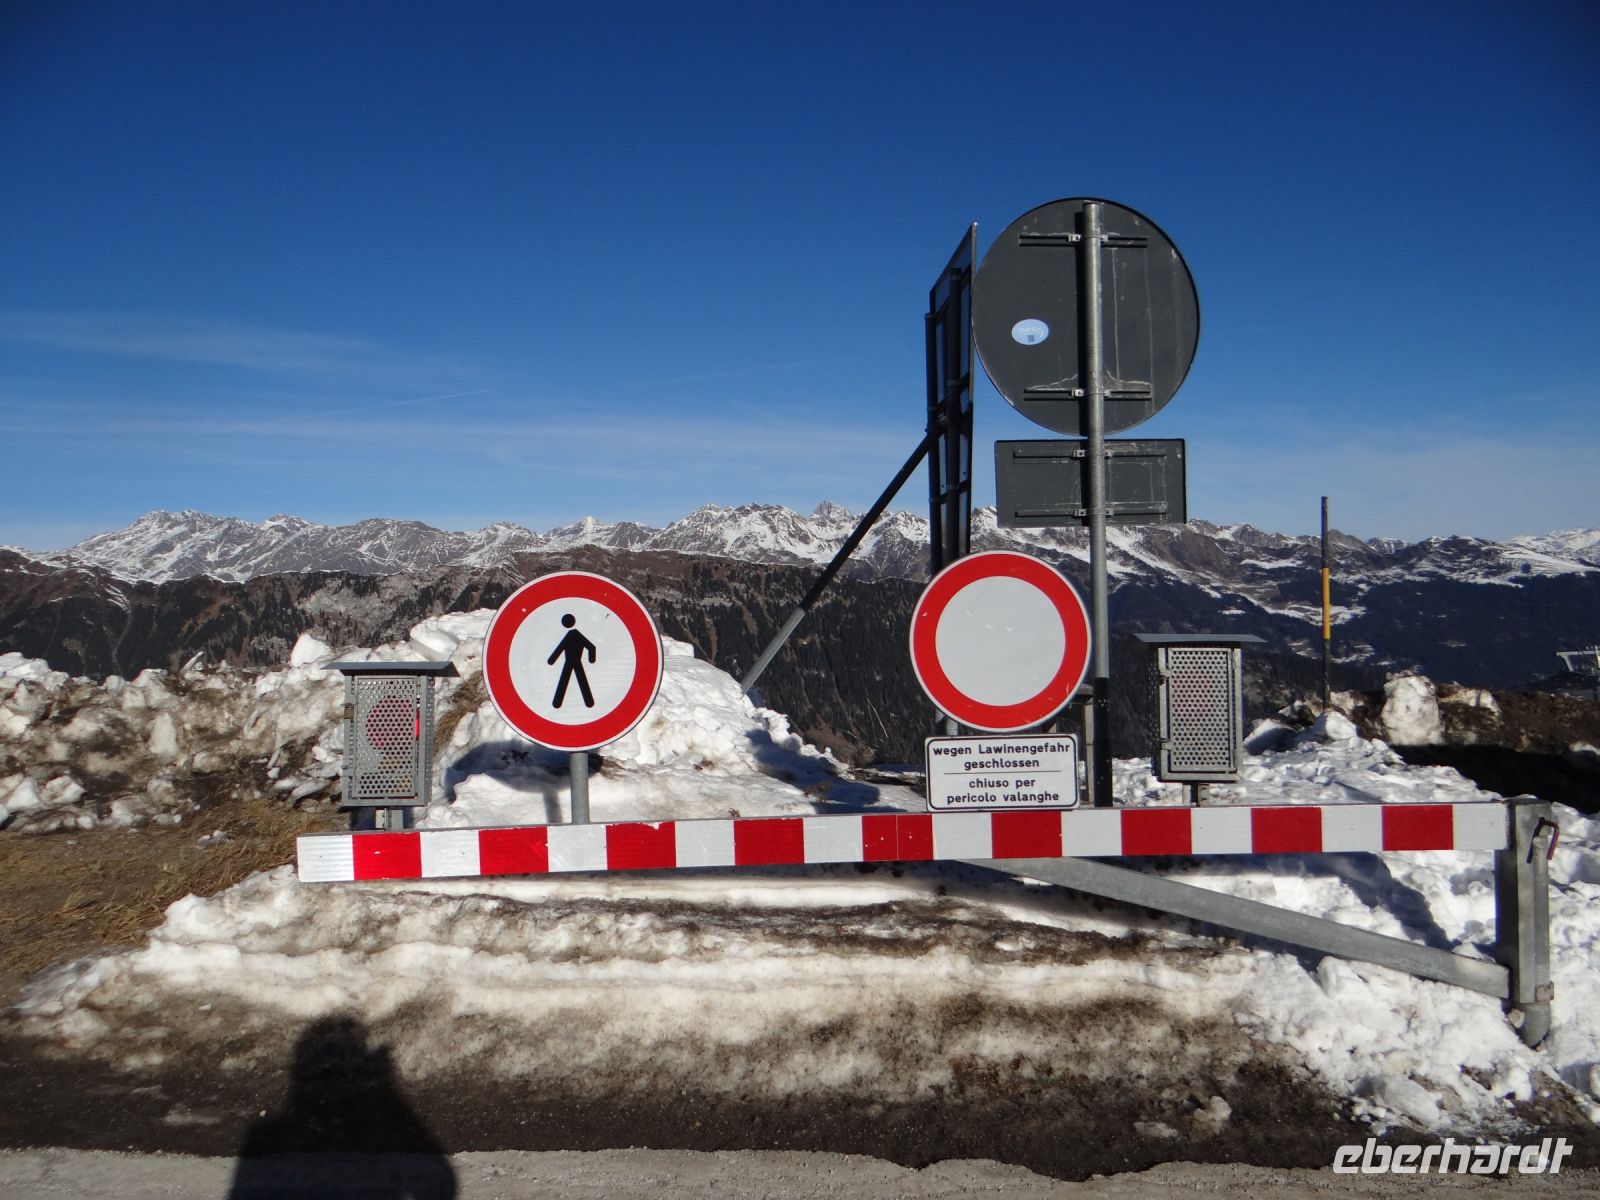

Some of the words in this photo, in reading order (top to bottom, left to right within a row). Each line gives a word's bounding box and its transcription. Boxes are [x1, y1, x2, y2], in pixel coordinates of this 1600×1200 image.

[933, 746, 972, 757] wegen
[979, 742, 1070, 755] Lawinengefahr
[964, 758, 1040, 771] geschlossen
[969, 778, 1009, 788] chiuso
[1015, 779, 1036, 790] per
[947, 792, 997, 805] pericolo
[1003, 790, 1059, 803] valanghe
